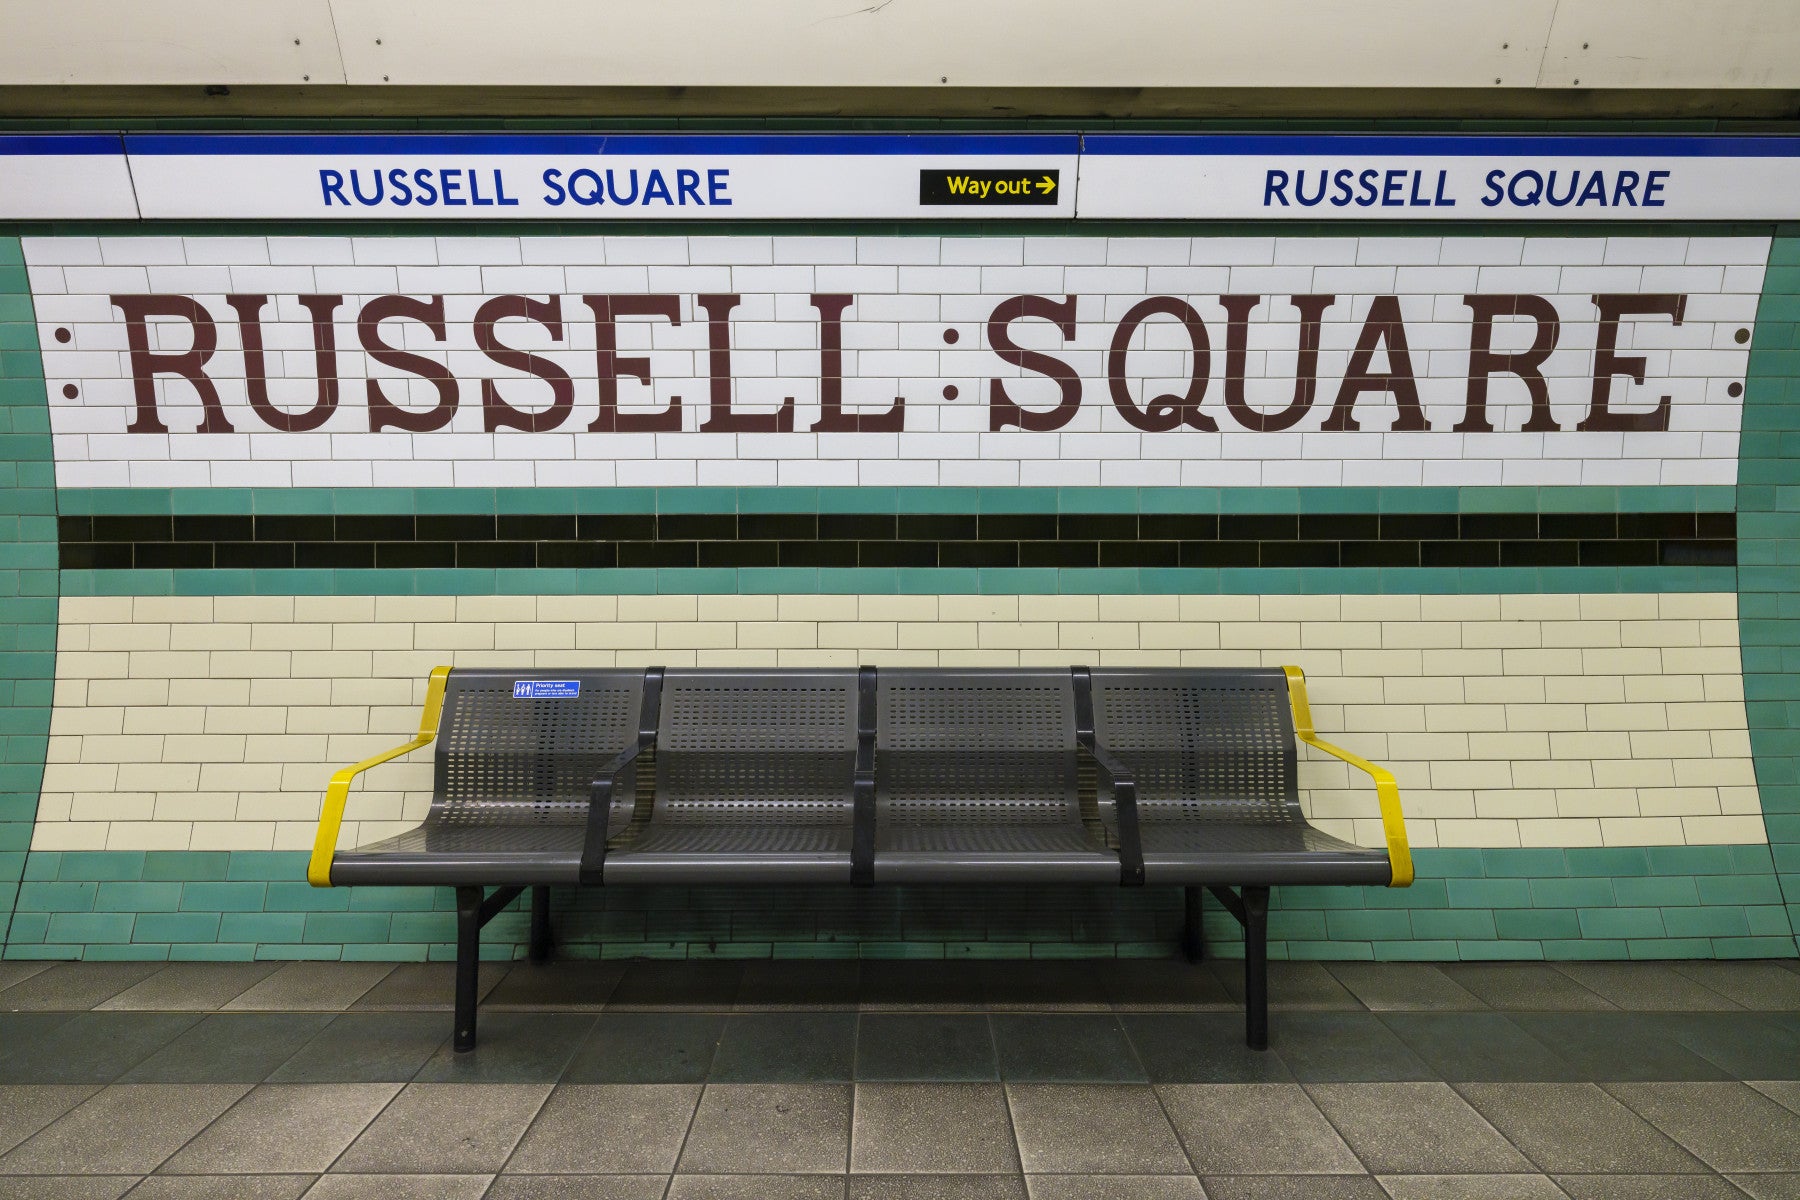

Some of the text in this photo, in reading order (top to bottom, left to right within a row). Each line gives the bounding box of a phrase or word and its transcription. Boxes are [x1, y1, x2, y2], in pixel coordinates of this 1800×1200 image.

[319, 168, 733, 206] RUSSELL SQUARE
[946, 176, 1031, 199] Way out
[1263, 169, 1671, 207] RUSSELL SQUARE
[110, 294, 1688, 434] RUSSELL SQUARE
